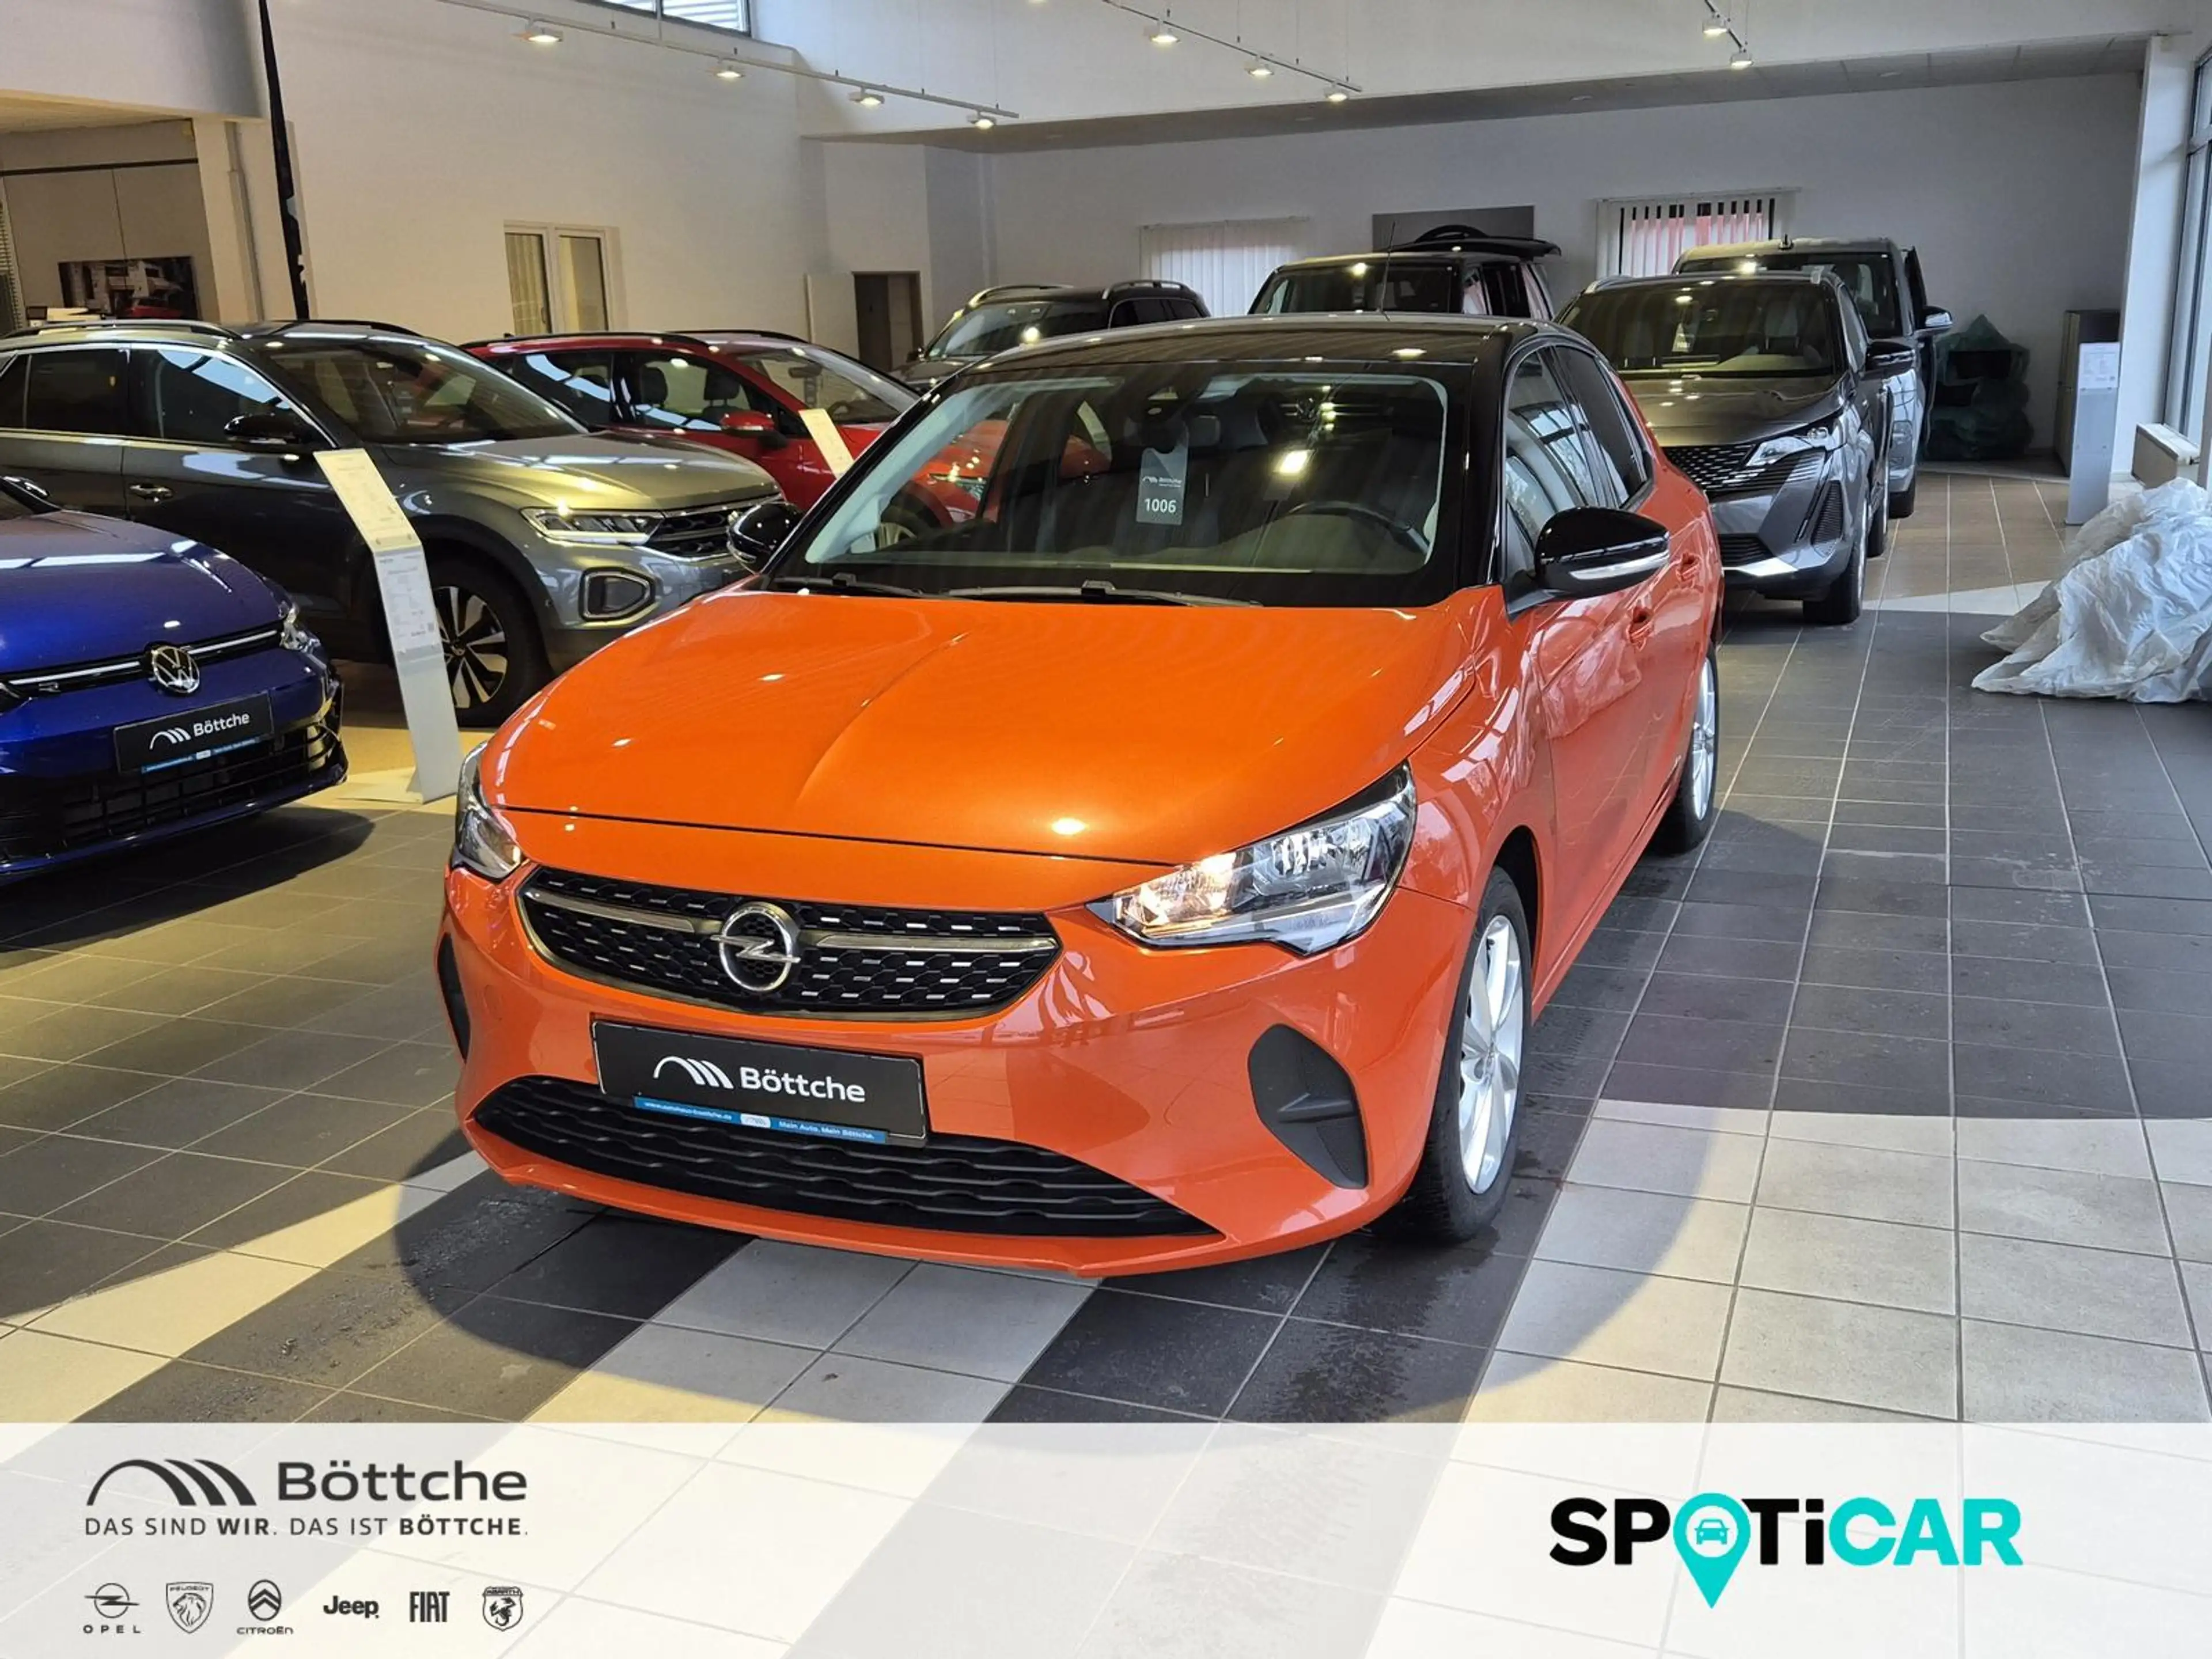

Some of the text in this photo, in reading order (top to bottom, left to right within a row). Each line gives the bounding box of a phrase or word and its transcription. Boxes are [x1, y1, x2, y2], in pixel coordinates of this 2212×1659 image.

[1145, 498, 1176, 513] 1006
[193, 712, 250, 737] Böttche
[739, 1066, 865, 1103] Böttche
